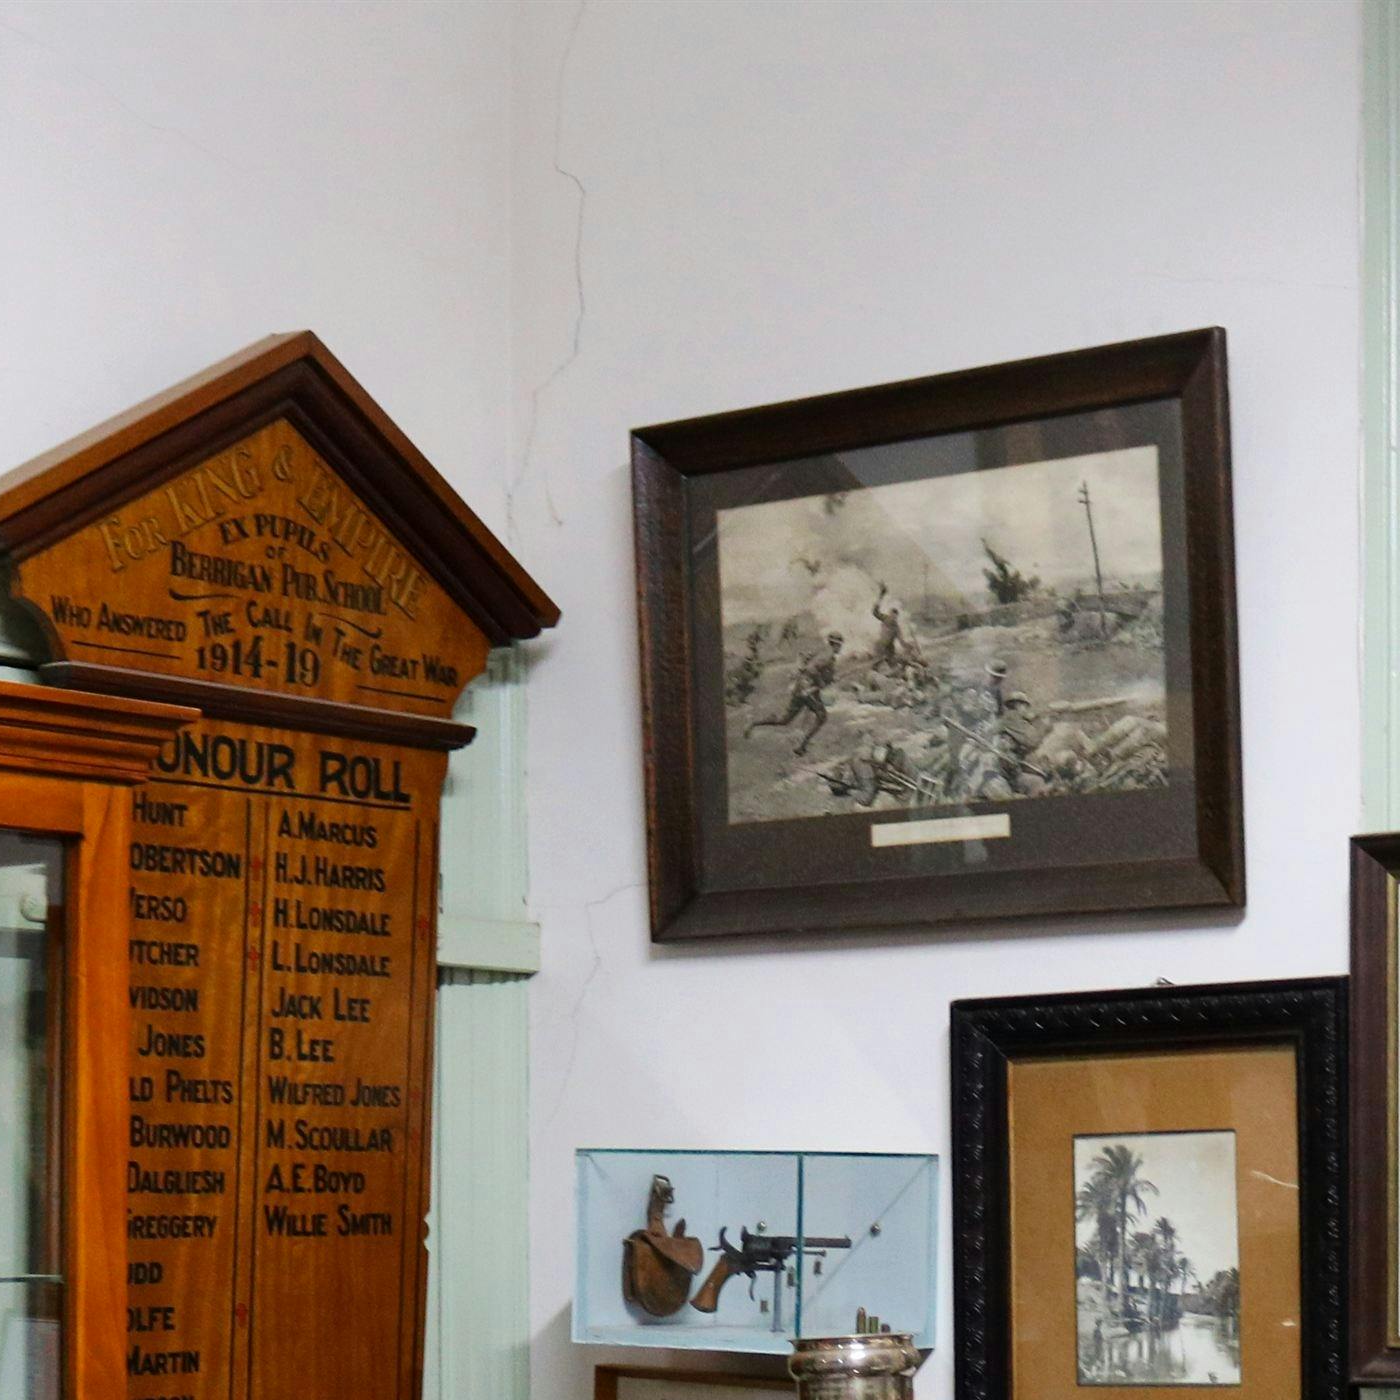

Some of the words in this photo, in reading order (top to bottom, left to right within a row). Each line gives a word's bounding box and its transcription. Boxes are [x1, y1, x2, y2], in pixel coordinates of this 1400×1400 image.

[166, 449, 265, 534] KING
[296, 456, 429, 622] EMPIRE
[219, 516, 250, 546] EX
[254, 512, 331, 565] PUPILS
[169, 539, 273, 594] BERRIGAN
[51, 594, 92, 630] WHO
[97, 602, 188, 643] ANSWERED
[196, 608, 236, 638] THE
[245, 599, 294, 635] CALL
[332, 625, 363, 672] THE
[368, 643, 419, 681] GREAT
[421, 652, 460, 689] WAR
[196, 633, 322, 689] 1914-19
[148, 730, 296, 790] ONOUR
[319, 750, 412, 804] ROLL
[131, 790, 188, 828] HUNT
[271, 986, 323, 1021] JACK
[333, 987, 371, 1024] LEE
[137, 1023, 206, 1059] JONES
[267, 1075, 345, 1108] WILFRED
[349, 1078, 401, 1108] JONES
[129, 1114, 232, 1149] BURWOOD
[127, 1160, 227, 1195] DALGLIESH
[264, 1204, 328, 1238] WILLIE
[336, 1203, 394, 1237] SMITH
